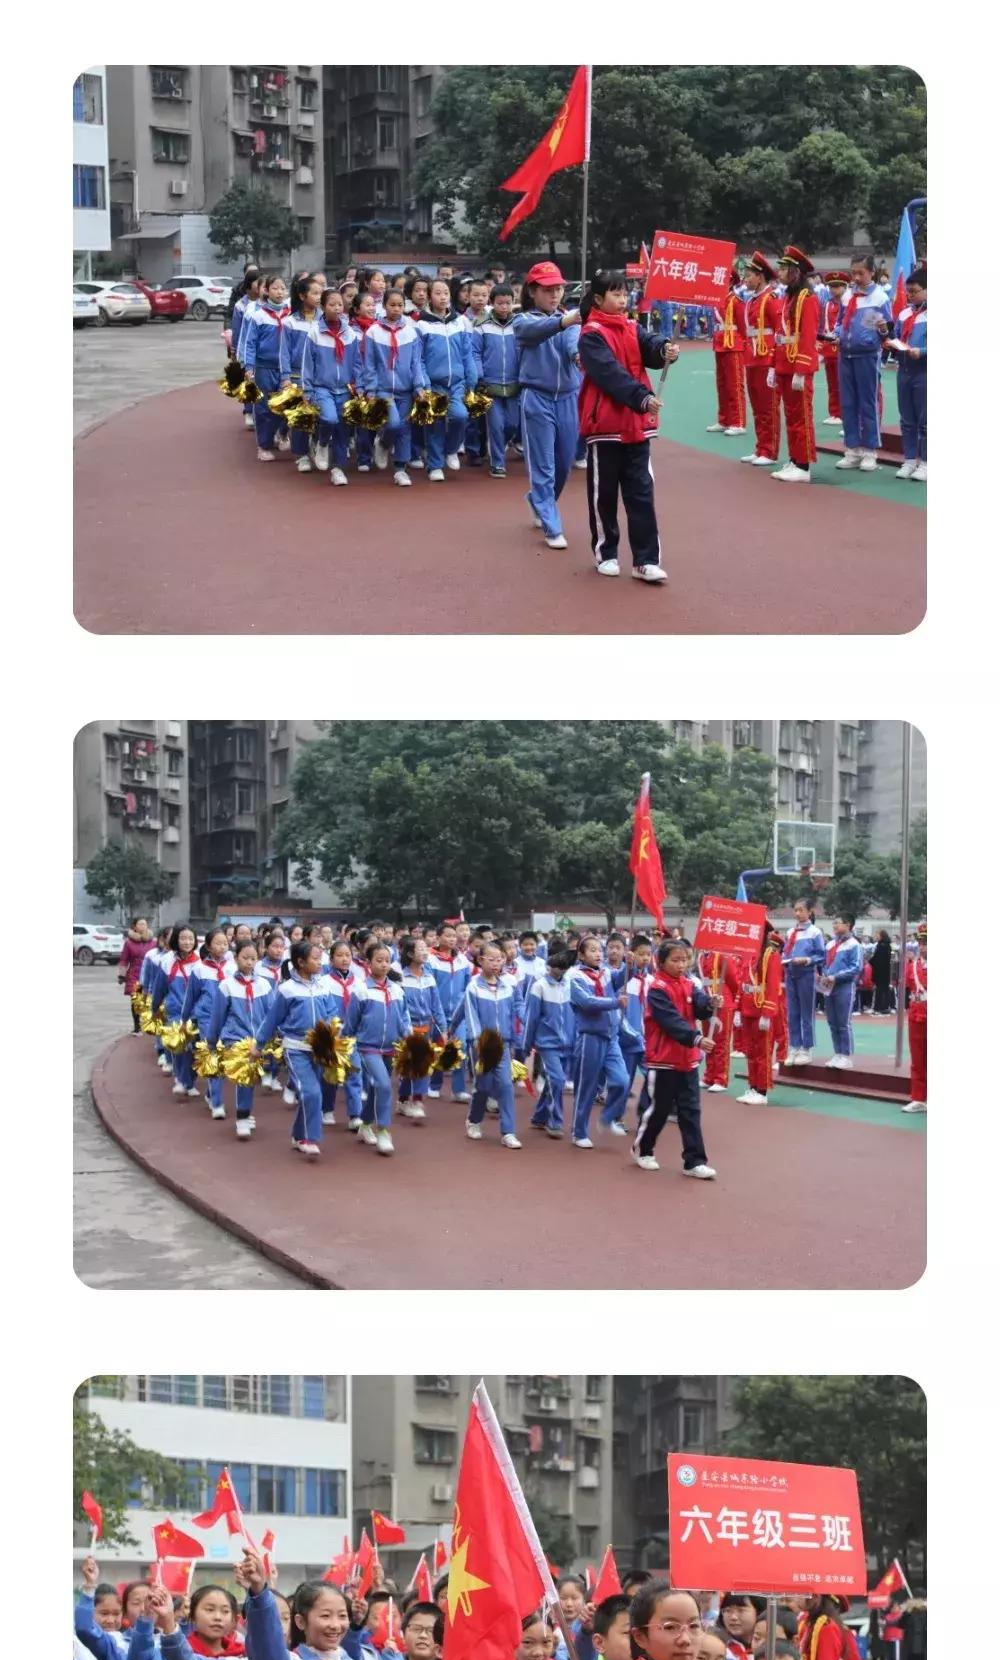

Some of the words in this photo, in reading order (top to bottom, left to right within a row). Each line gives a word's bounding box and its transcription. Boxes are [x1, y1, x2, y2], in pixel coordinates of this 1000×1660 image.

[652, 257, 728, 286] 六年级一班
[700, 916, 761, 941] 六年级二班
[679, 1504, 854, 1552] 六年级三班
